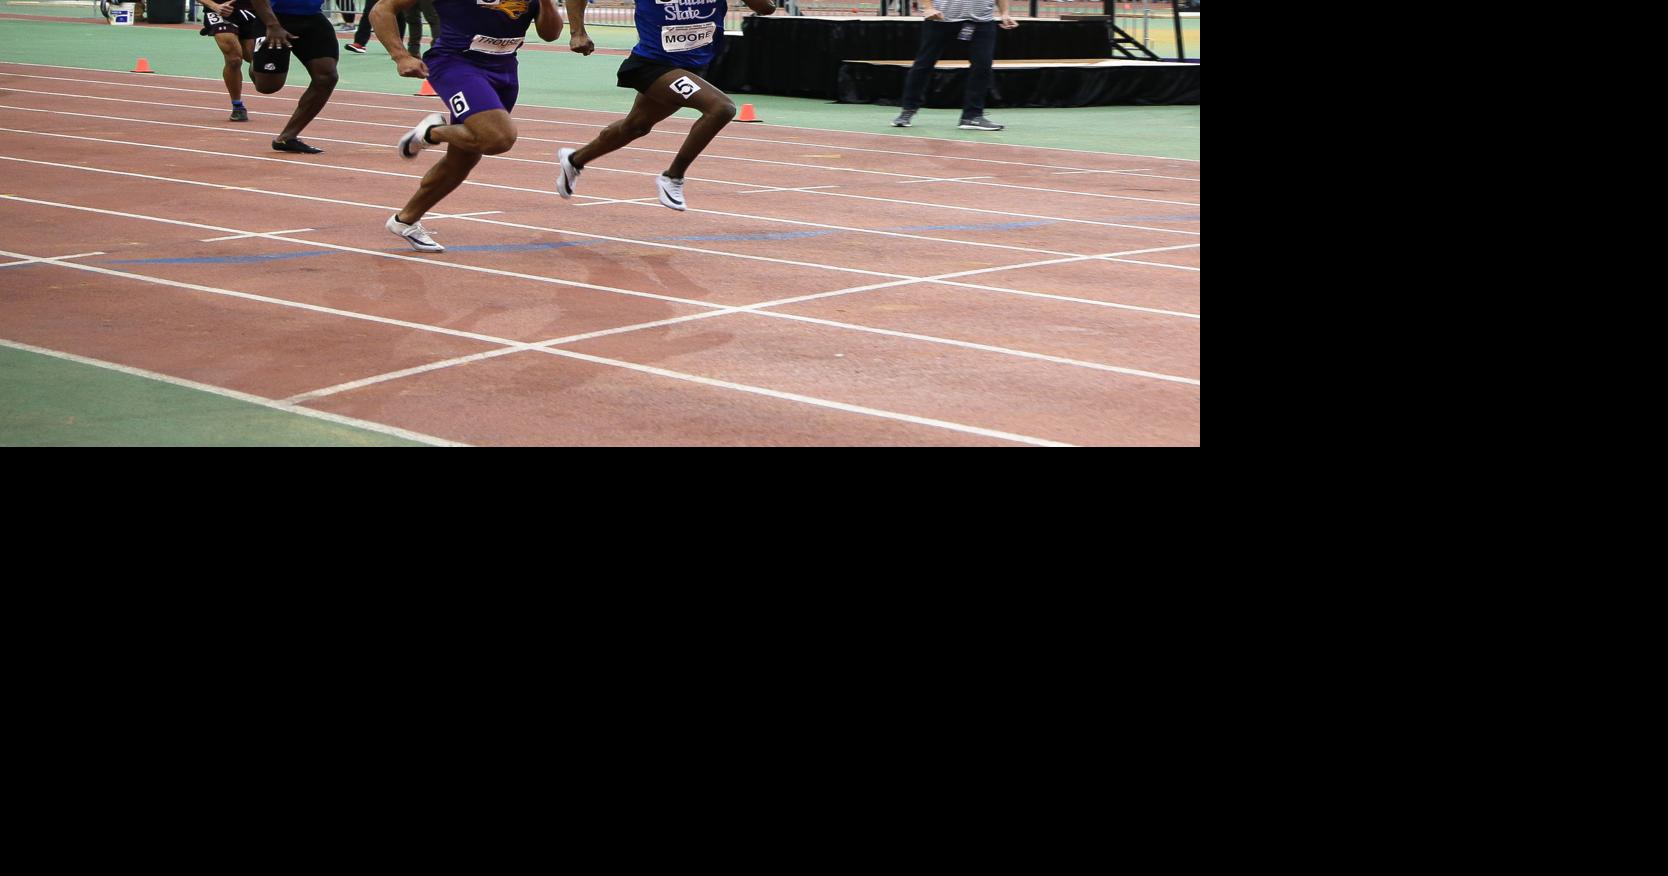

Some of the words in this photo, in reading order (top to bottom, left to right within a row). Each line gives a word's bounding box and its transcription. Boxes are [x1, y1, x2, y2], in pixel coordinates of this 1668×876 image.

[664, 4, 716, 20] State
[665, 31, 712, 43] MOORE
[674, 79, 694, 95] 5
[452, 95, 465, 114] 6
